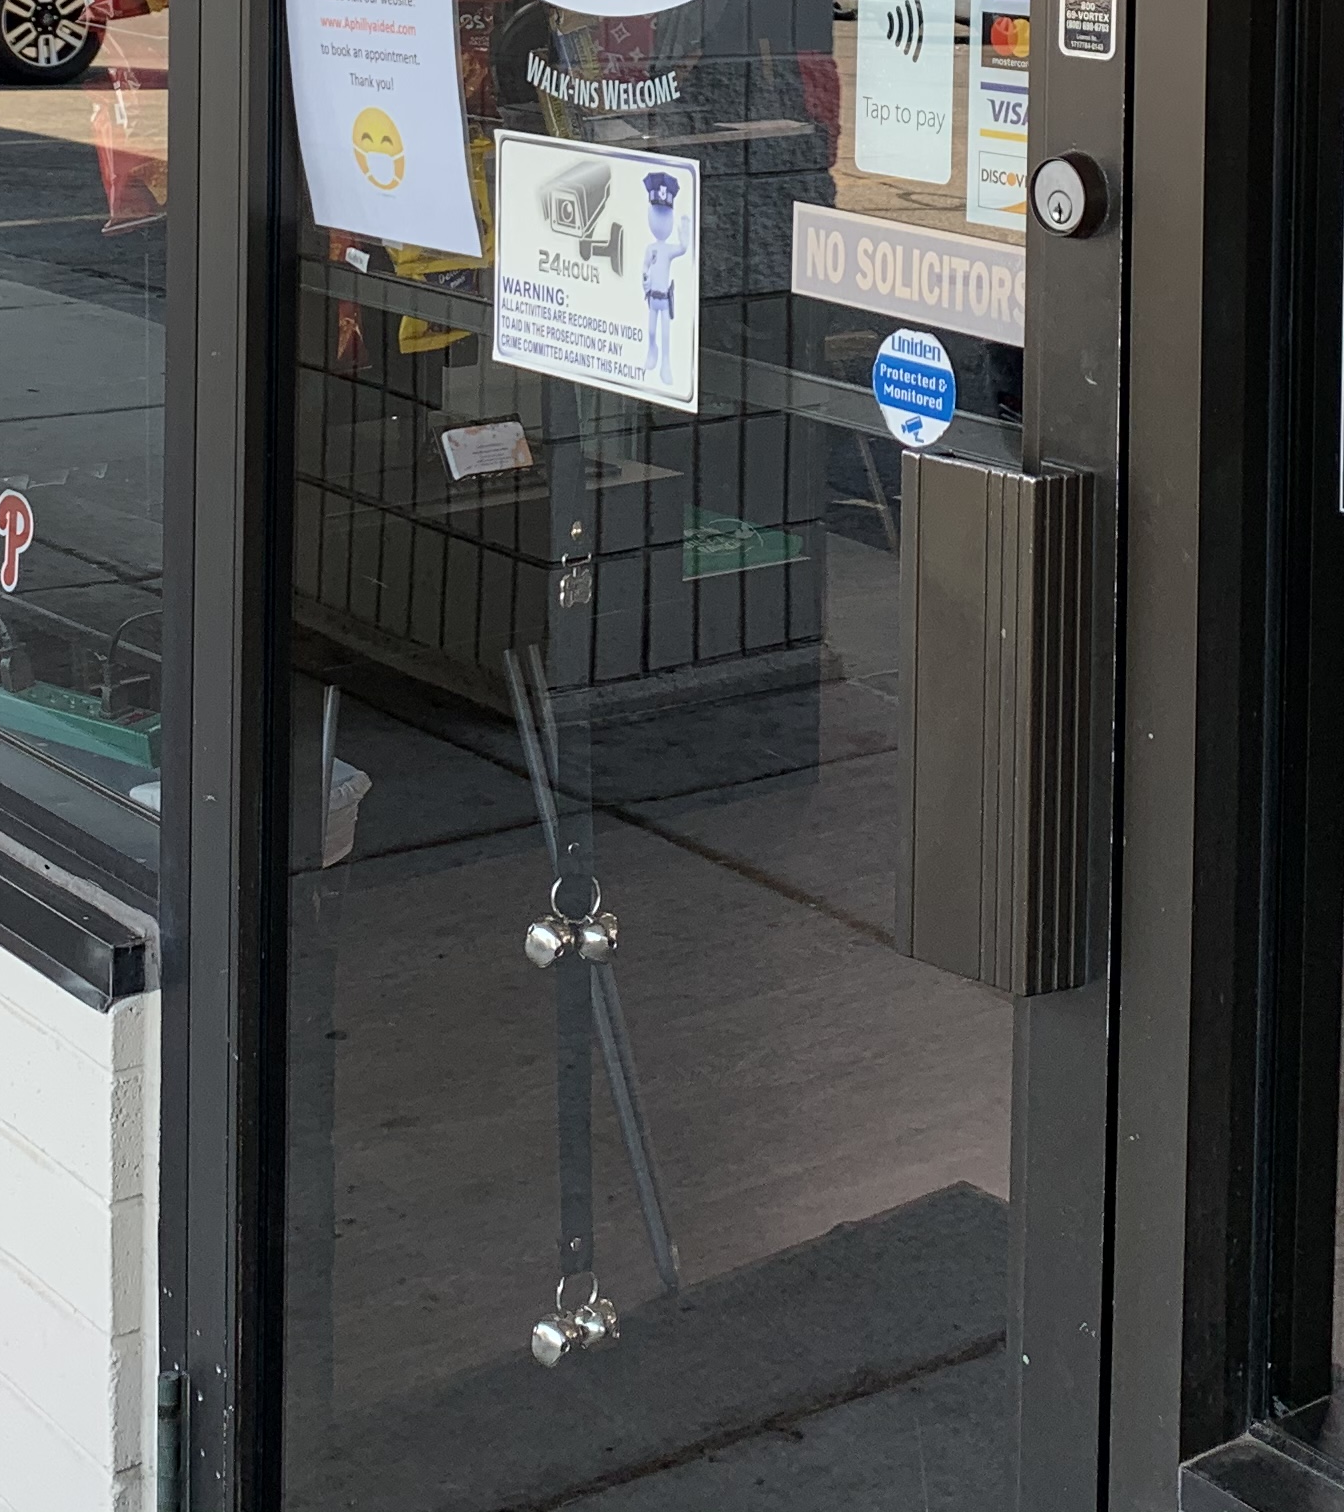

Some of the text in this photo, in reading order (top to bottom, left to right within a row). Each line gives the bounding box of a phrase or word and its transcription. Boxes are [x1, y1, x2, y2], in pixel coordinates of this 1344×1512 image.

[1066, 9, 1110, 23] 69-VORTEX
[1080, 1, 1096, 12] 800
[320, 17, 417, 36] www.Aphillyaided.com
[320, 43, 420, 66] to book an appointment.
[992, 57, 1029, 68] mastercar
[349, 72, 394, 92] Thank you!
[526, 50, 681, 111] WALK-INS WELCOME
[863, 96, 946, 135] Tap to pay
[981, 168, 1027, 189] DISCOV
[806, 226, 1026, 326] NO SOLICITORS
[502, 276, 570, 308] WARNING:
[501, 299, 643, 343] ALL ACTIVITIES ARE RECORDED ON VIDEO
[501, 315, 623, 357] TO AID IN THE PROSECUTION OF ANY
[501, 334, 647, 382] CRIME COMMITTED AGAINST THIS FACILITY
[891, 334, 941, 363] Uniden
[879, 363, 948, 393] Protected &
[883, 382, 943, 412] Monitored
